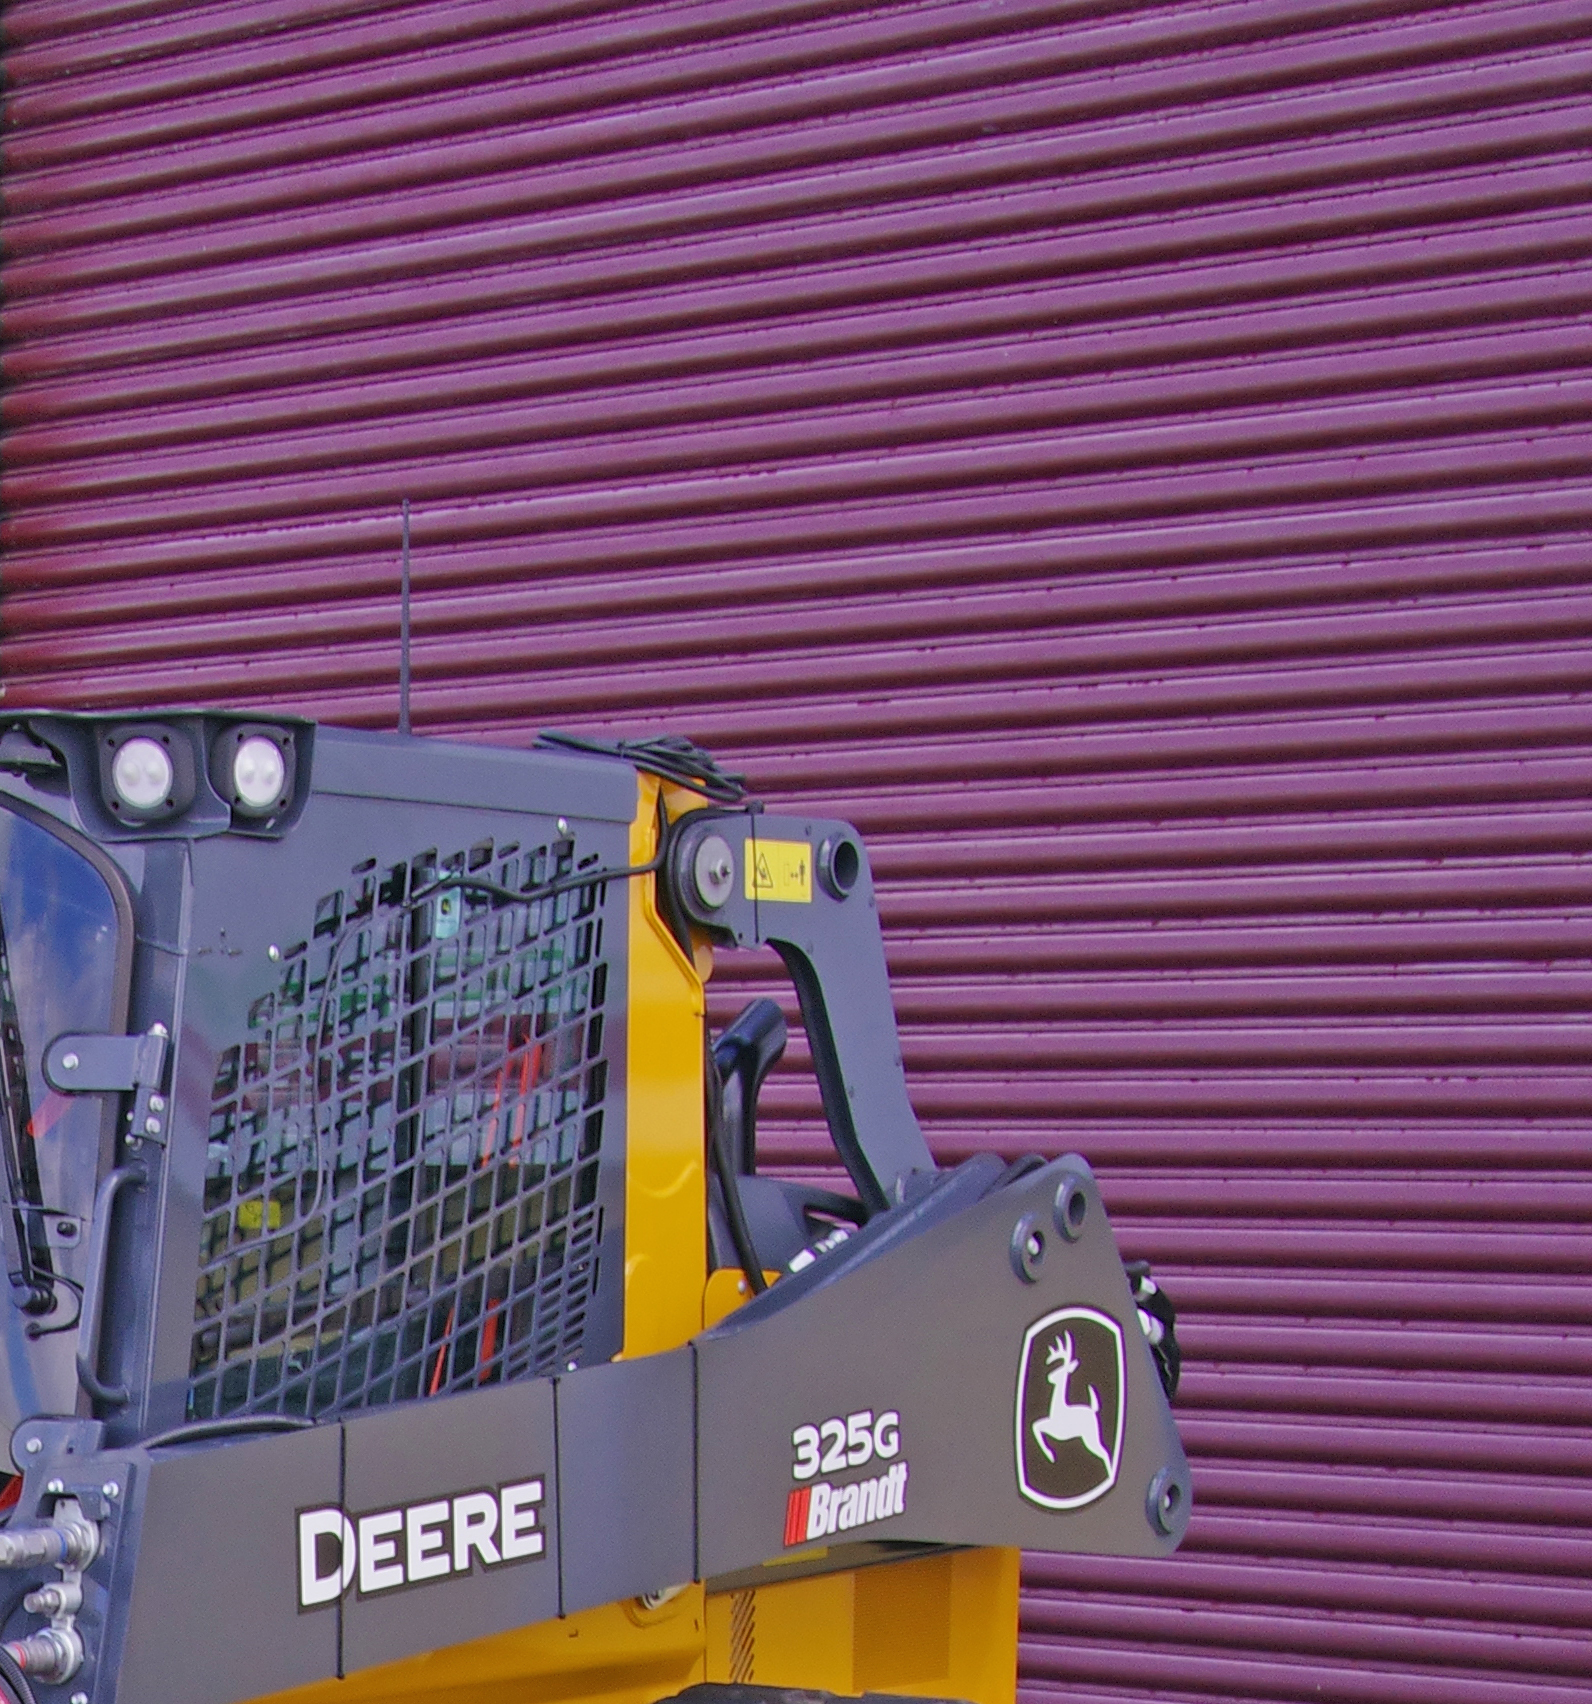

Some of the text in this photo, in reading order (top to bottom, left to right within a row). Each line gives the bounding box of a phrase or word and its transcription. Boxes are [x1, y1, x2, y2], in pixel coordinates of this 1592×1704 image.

[792, 1411, 900, 1480] 325G
[806, 1461, 908, 1541] Brandt
[299, 1479, 544, 1607] DEERE
